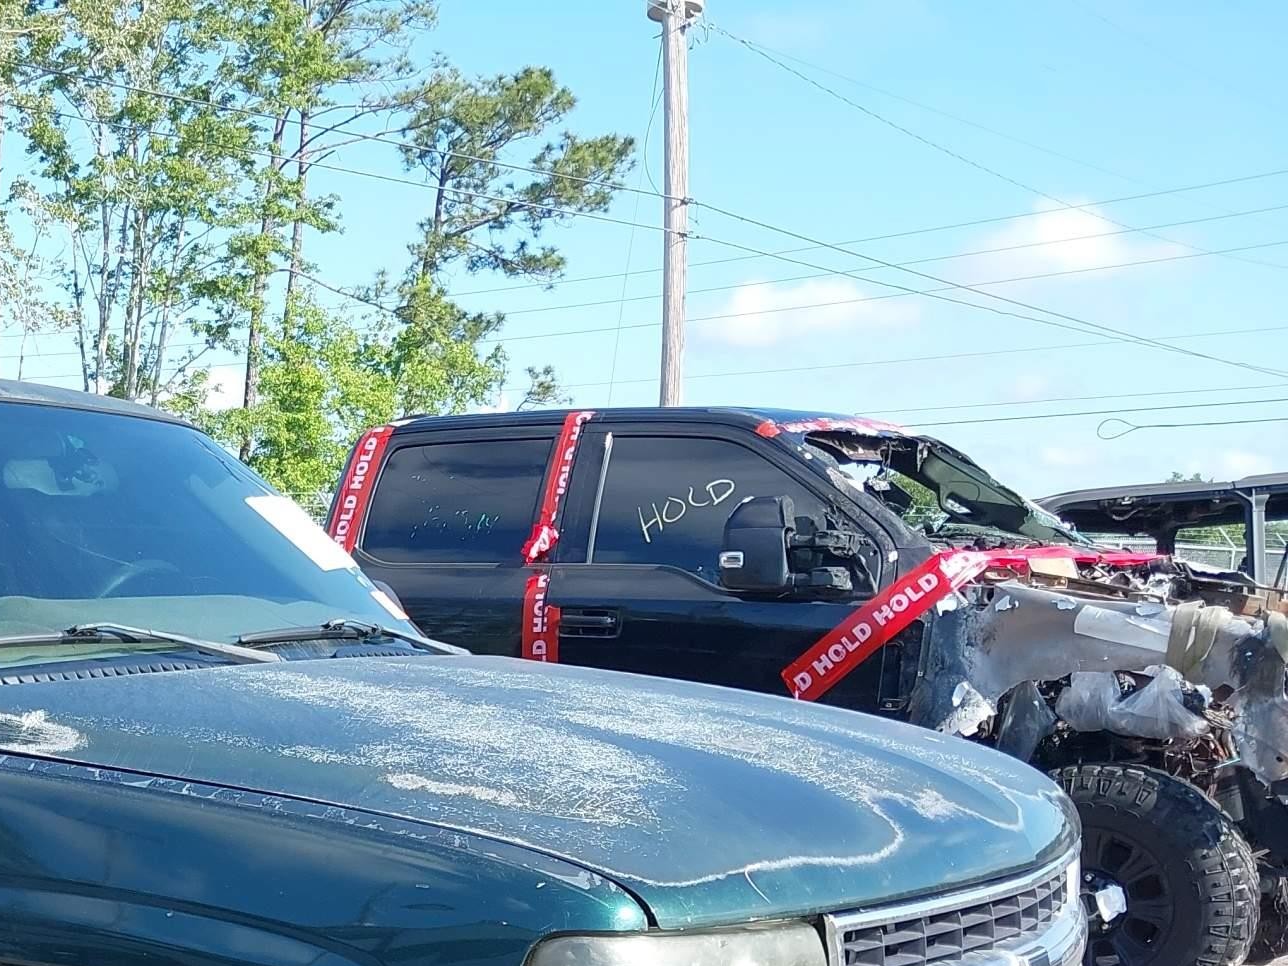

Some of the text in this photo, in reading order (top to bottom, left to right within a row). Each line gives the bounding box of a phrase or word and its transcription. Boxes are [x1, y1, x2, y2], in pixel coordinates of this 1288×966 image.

[350, 437, 378, 490] HOLD
[637, 479, 735, 543] HOLD
[811, 622, 873, 677] HOLD
[872, 573, 940, 627] HOLD
